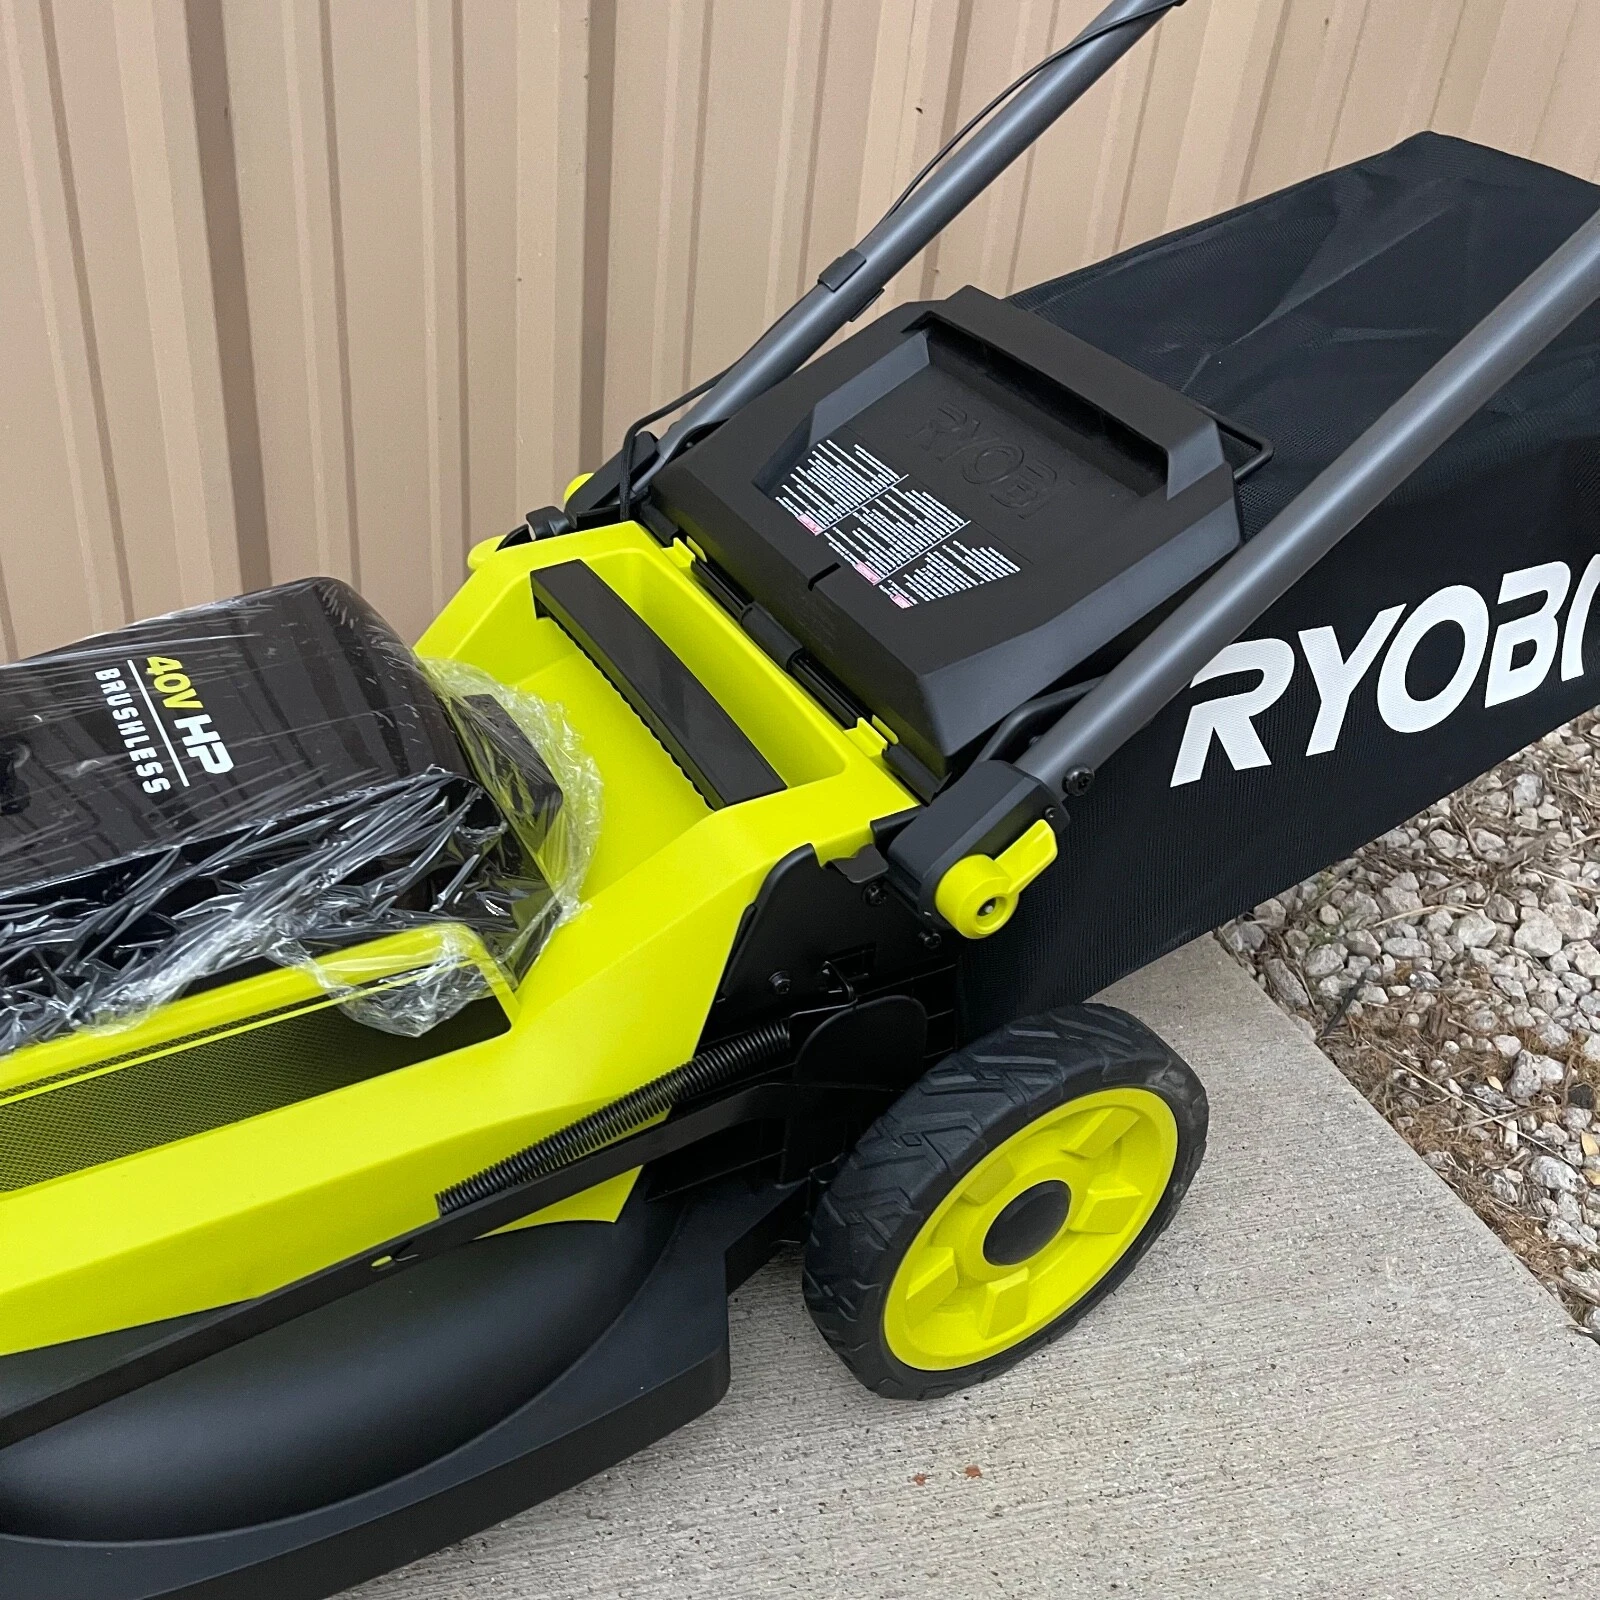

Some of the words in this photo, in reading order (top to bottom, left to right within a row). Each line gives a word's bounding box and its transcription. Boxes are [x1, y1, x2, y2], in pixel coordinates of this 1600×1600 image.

[906, 402, 1077, 520] RYOBI
[146, 656, 204, 709] 40V
[94, 667, 171, 794] BRUSHLESS
[173, 714, 234, 775] HP
